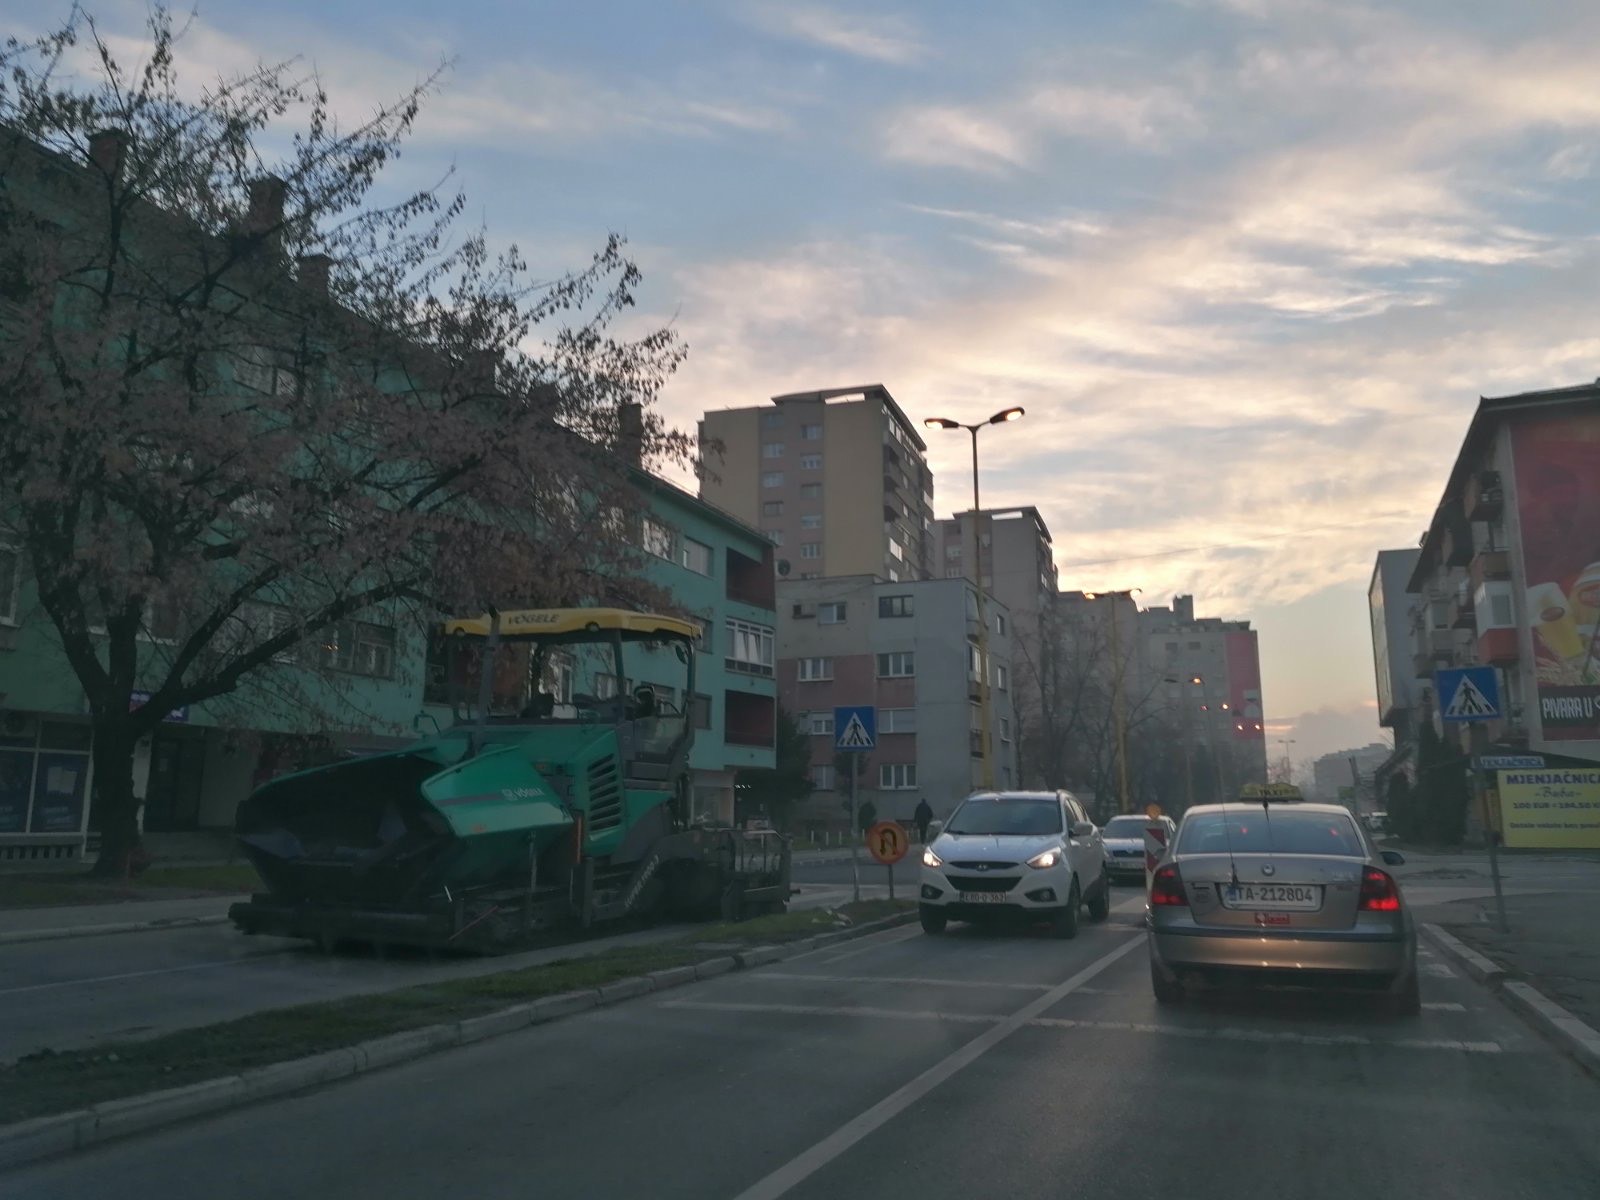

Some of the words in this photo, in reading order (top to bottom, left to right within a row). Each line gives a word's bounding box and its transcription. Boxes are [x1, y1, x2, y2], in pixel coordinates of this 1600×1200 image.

[1542, 697, 1582, 719] PIVARA
[1582, 696, 1593, 718] U
[1239, 884, 1313, 902] TA-212804
